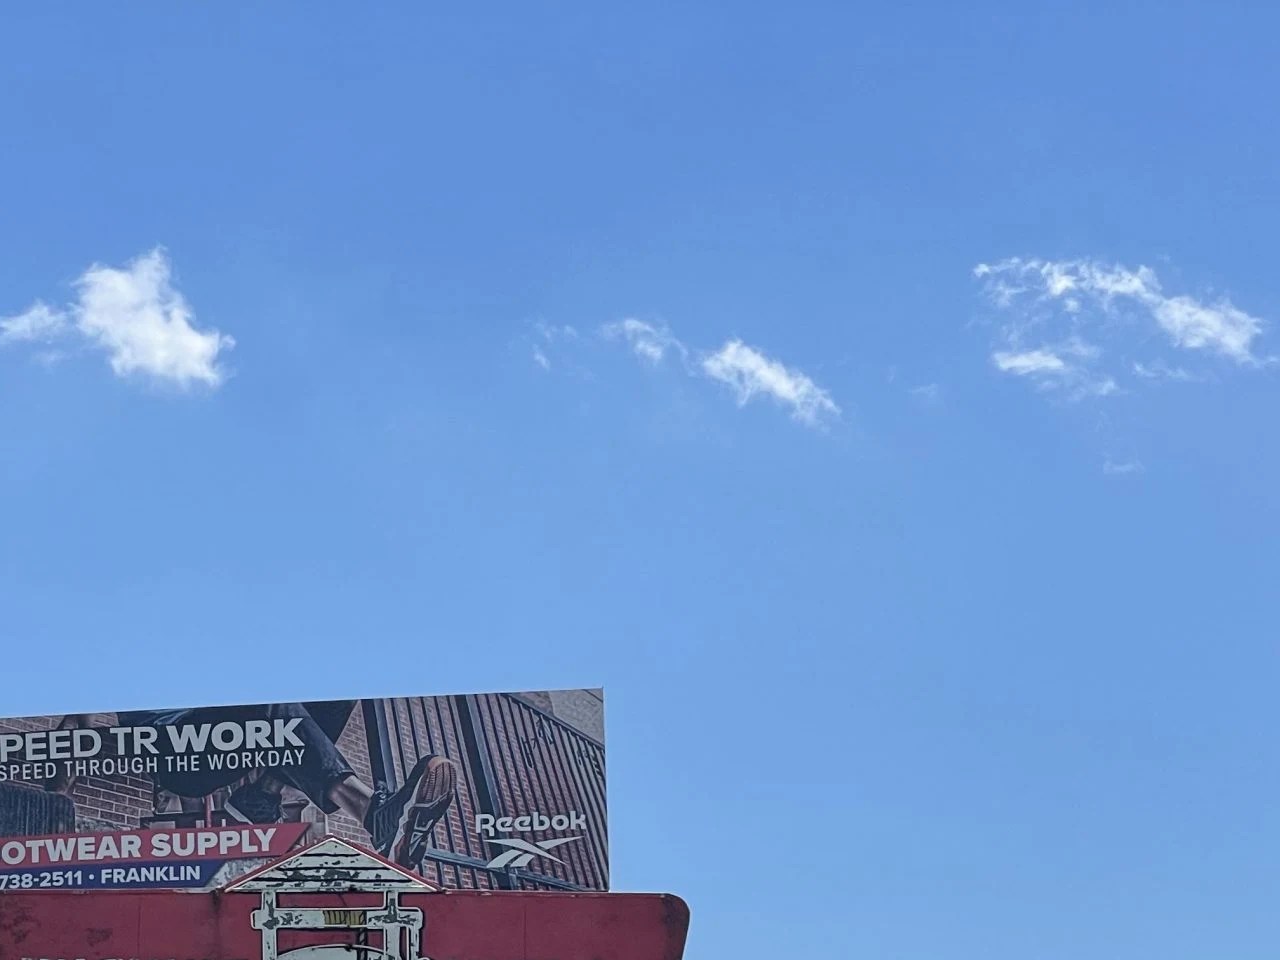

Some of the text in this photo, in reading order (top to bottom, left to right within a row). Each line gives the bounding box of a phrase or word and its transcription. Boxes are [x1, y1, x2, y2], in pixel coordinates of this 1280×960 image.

[111, 726, 159, 756] TR
[166, 717, 306, 753] WORK
[65, 755, 158, 777] THROUGH
[166, 753, 200, 772] THE
[207, 749, 305, 770] WORKDAY
[475, 811, 587, 837] Reebok
[151, 828, 277, 857] SUPPLY
[100, 865, 201, 884] FRANKLIN
